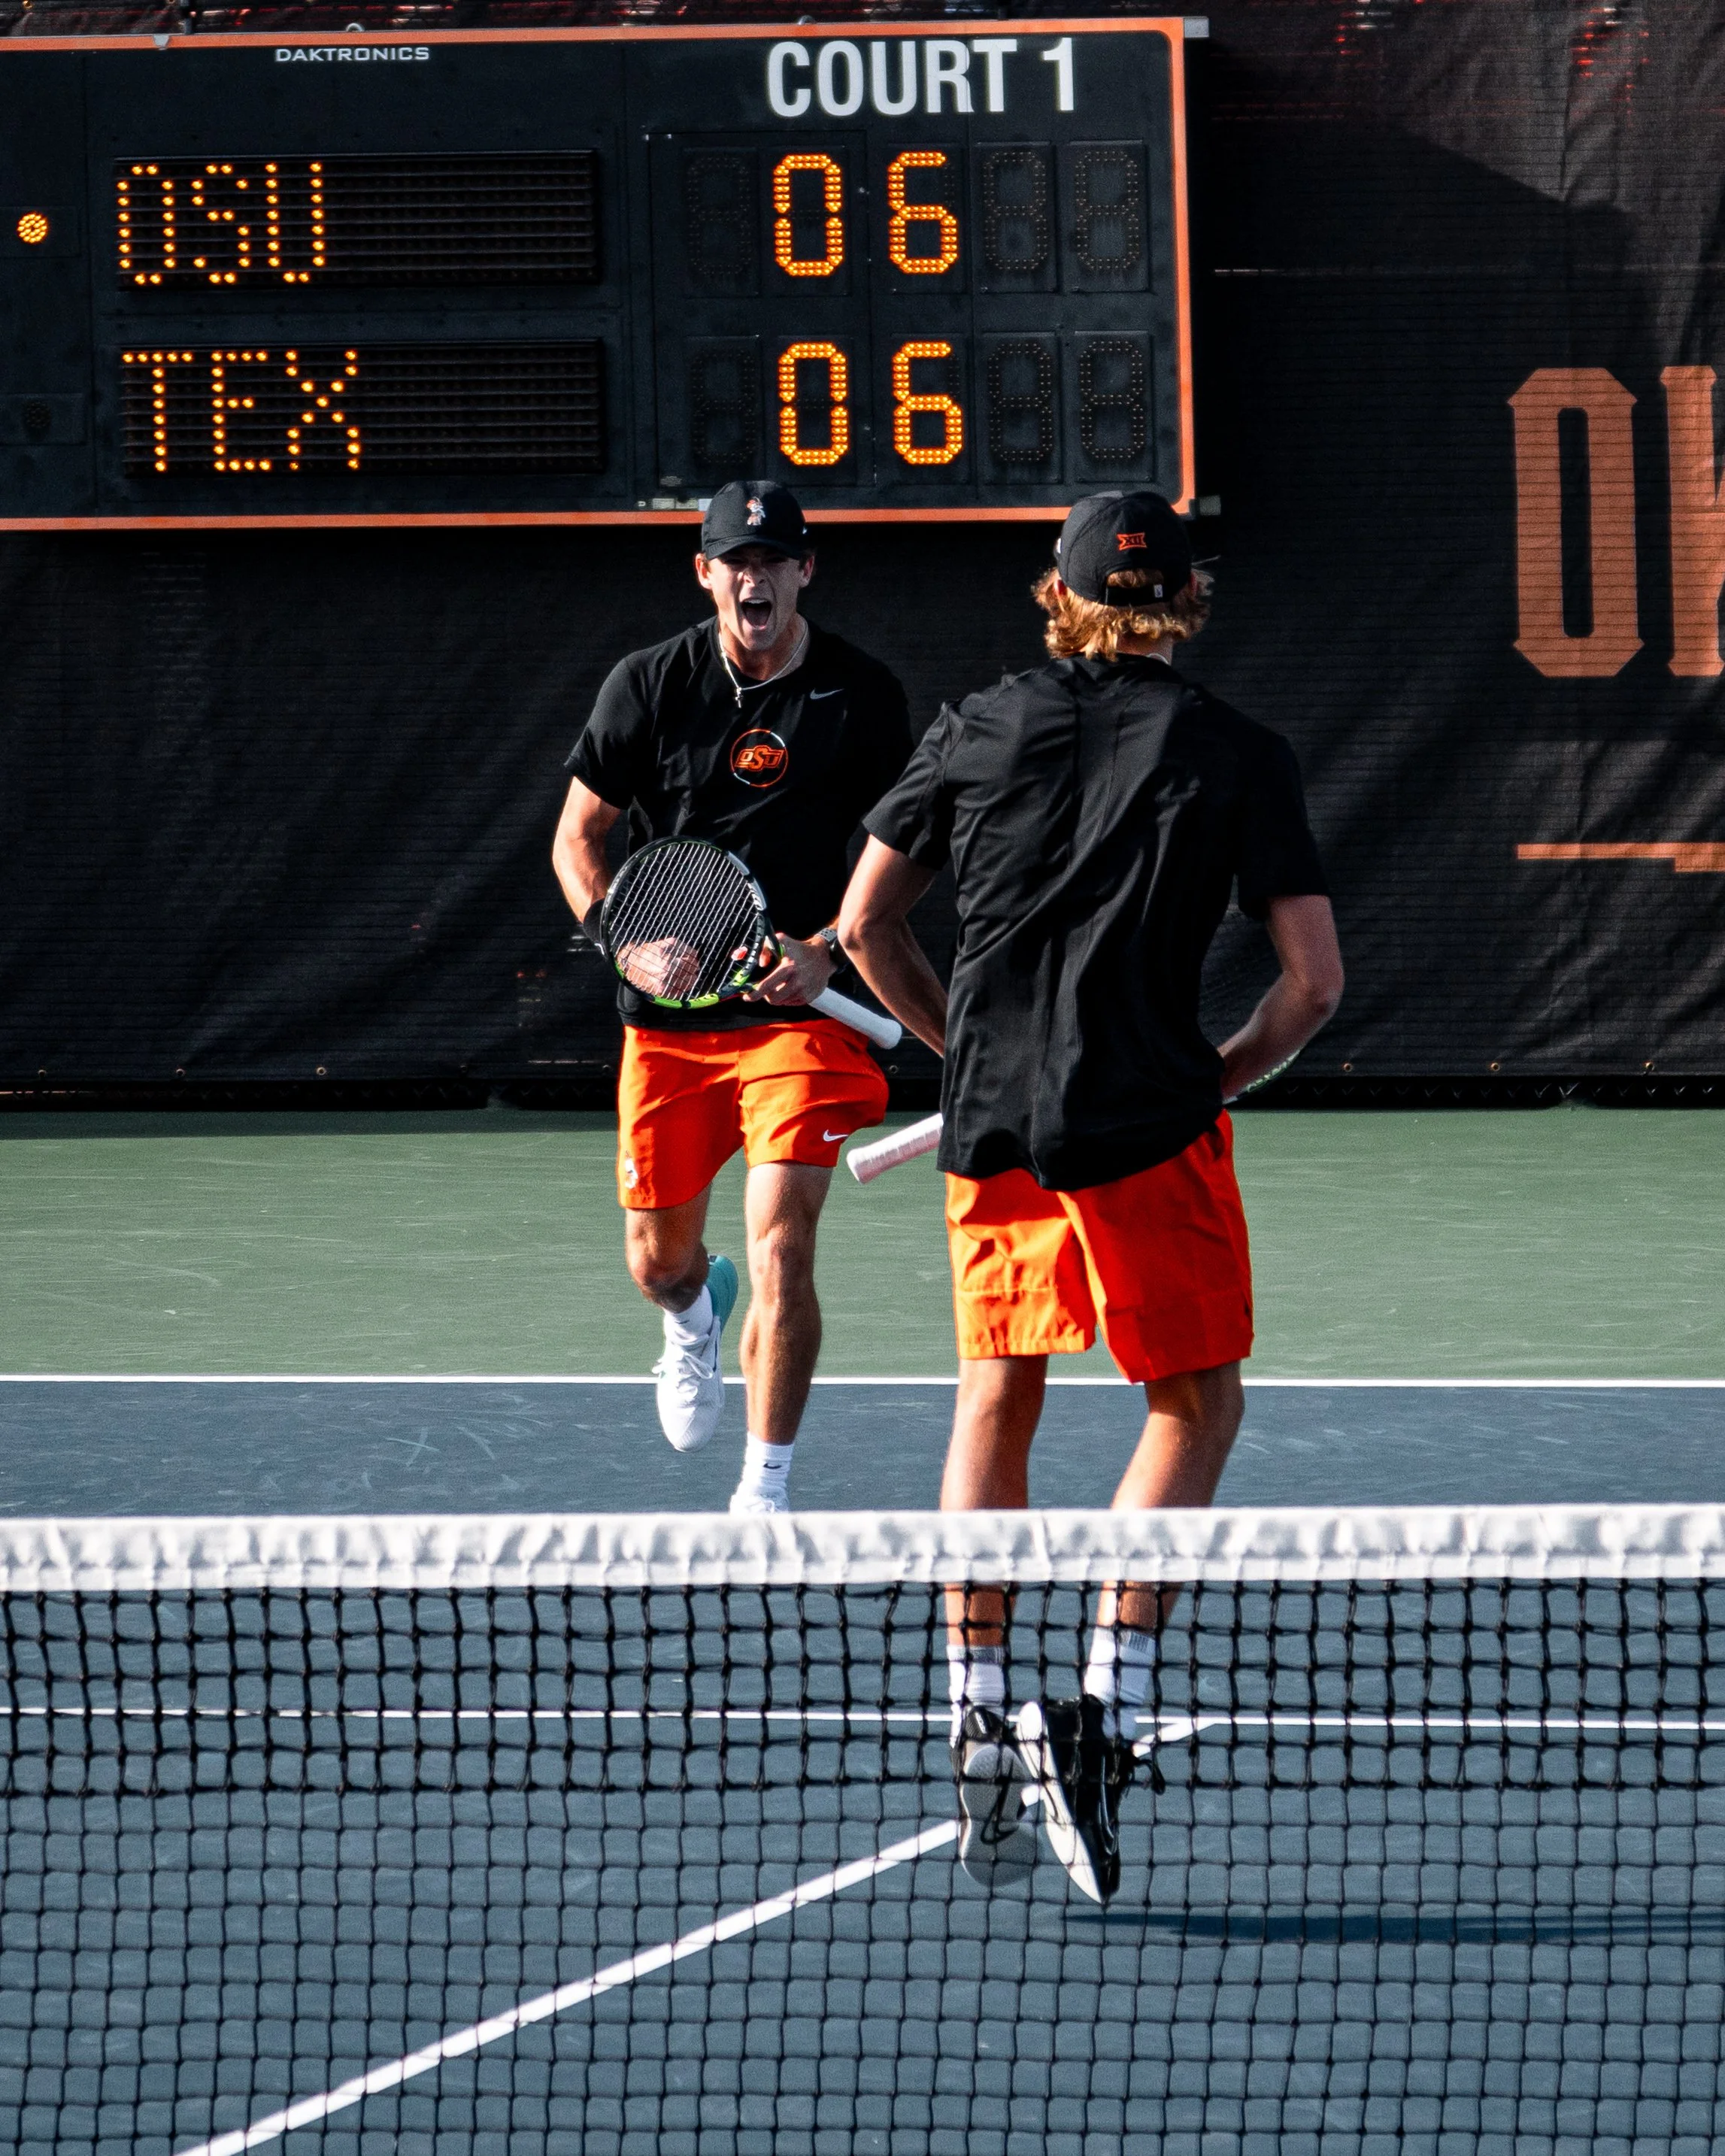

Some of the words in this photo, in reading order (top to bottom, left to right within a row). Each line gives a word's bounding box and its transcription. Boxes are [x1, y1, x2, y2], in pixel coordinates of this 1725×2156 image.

[274, 47, 430, 62] DAKTRONICS
[767, 38, 1017, 117] COURT
[1041, 37, 1075, 112] 1
[117, 162, 326, 286] OSU
[122, 350, 361, 472] TEX
[736, 744, 784, 770] OSU
